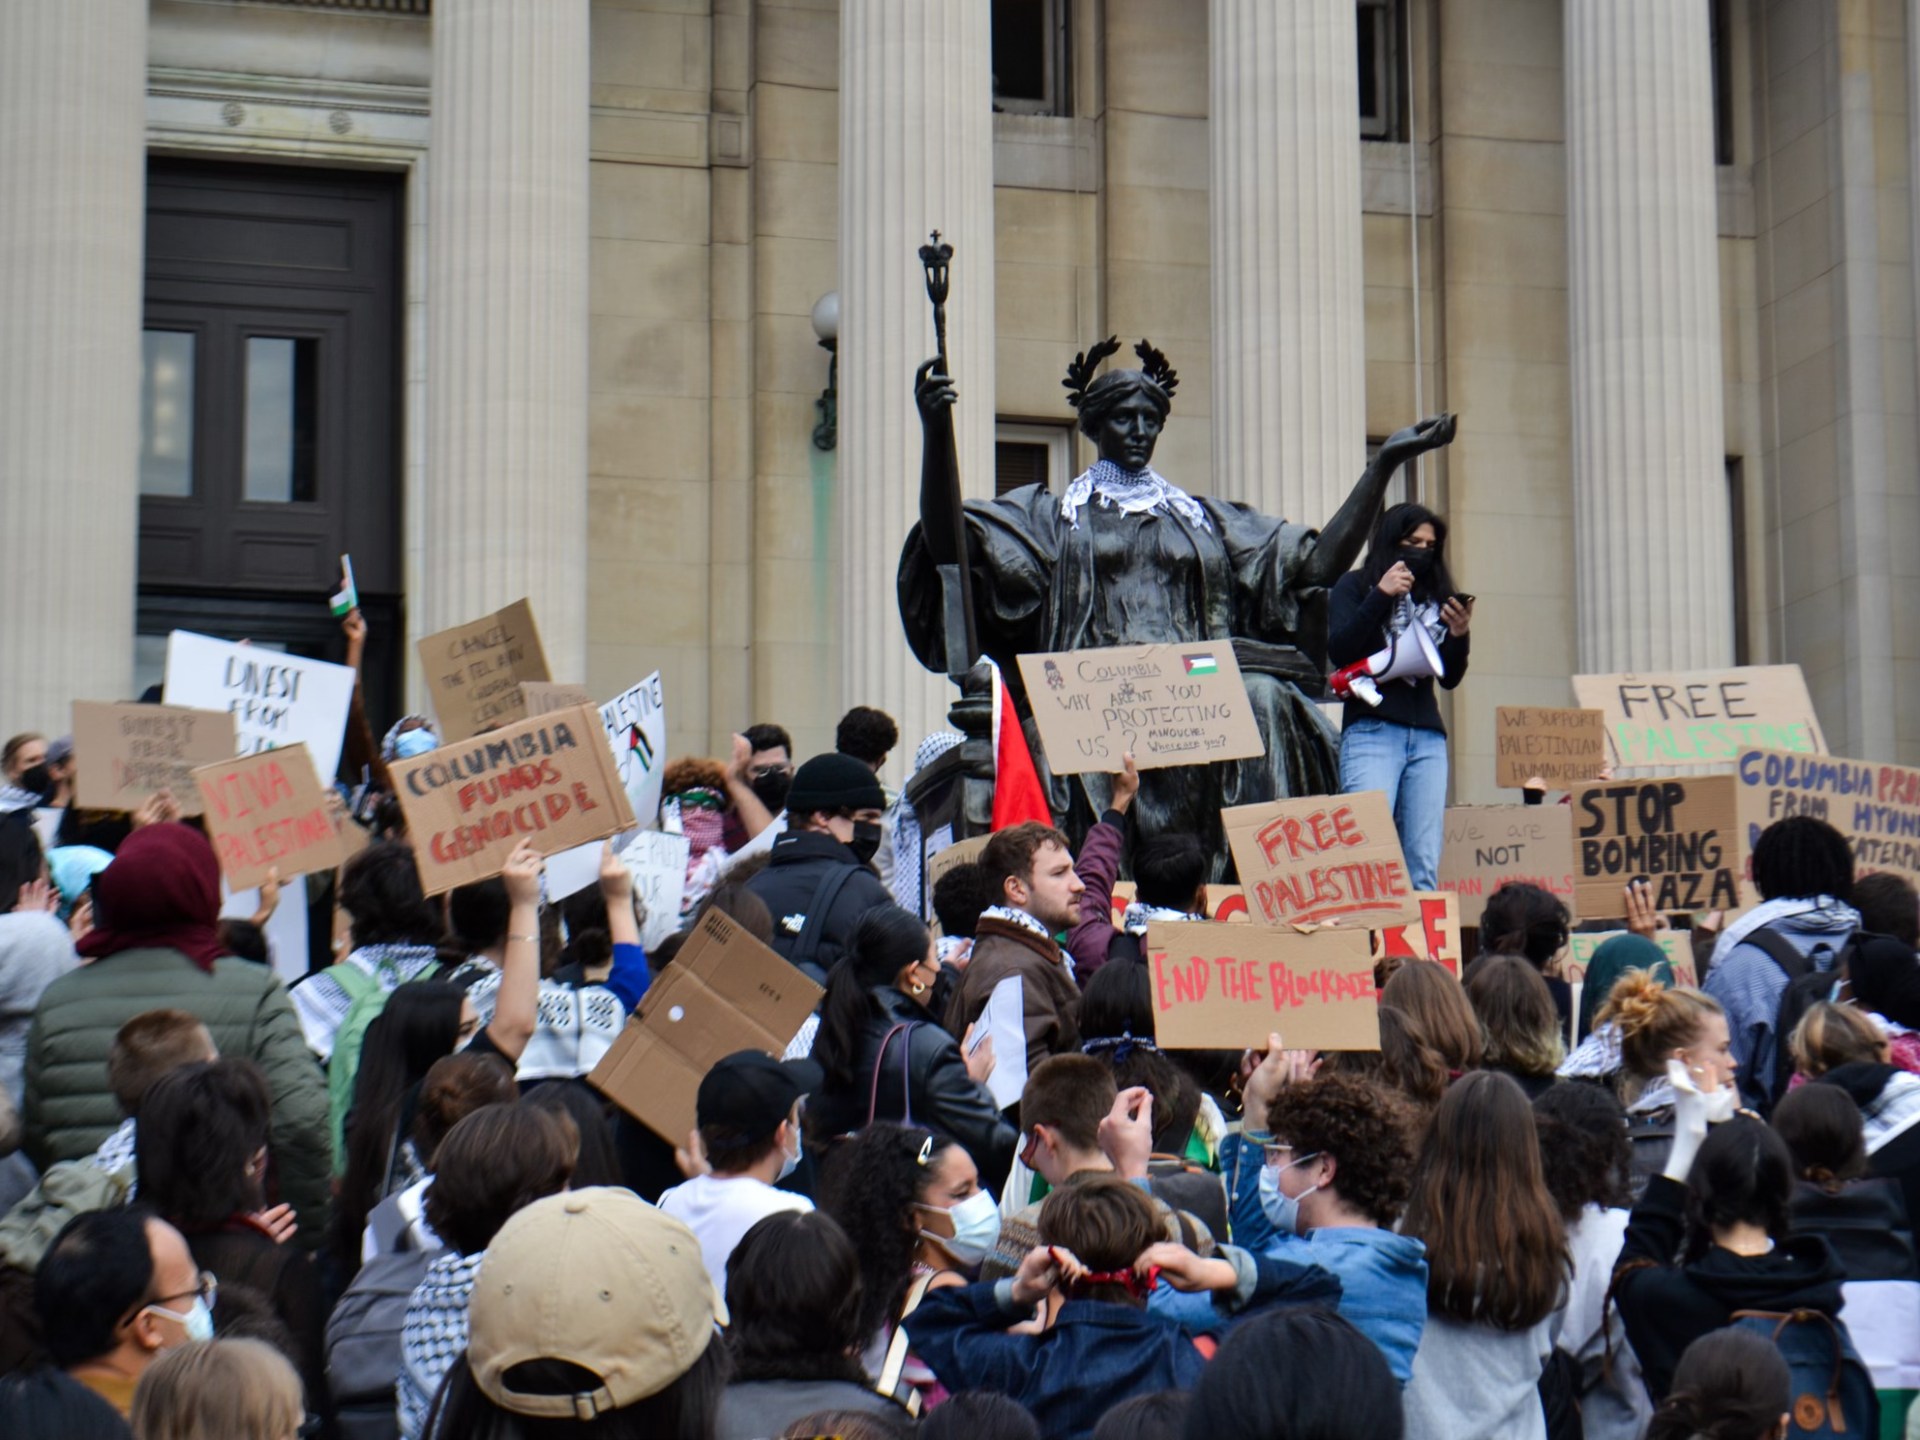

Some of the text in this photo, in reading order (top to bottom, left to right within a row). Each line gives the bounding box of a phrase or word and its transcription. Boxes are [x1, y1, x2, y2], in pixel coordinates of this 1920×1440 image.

[1077, 659, 1162, 681] COLUMBIA
[603, 676, 662, 735] ALESTINE
[1056, 692, 1091, 711] WHY
[1166, 684, 1201, 700] YOU
[1102, 702, 1231, 731] PROTECTING
[1503, 710, 1600, 728] WE SUPPORT
[1619, 682, 1757, 720] FREE
[404, 722, 577, 798] COLUMBIA
[1499, 734, 1602, 755] PALESTINIAN
[1619, 722, 1812, 763] PALESTINE
[202, 762, 294, 820] VIVA
[457, 759, 561, 814] FUNDS
[1511, 762, 1561, 781] HUMAN
[1740, 751, 1920, 806] COLUMBIA PRO
[430, 781, 599, 866] GENOCIDE
[1580, 783, 1685, 838] STOP
[1768, 789, 1829, 822] FROM
[1256, 807, 1363, 867] FREE
[1446, 819, 1546, 844] We are
[1583, 829, 1722, 877] BOMBING
[1475, 844, 1526, 867] NOT
[1255, 861, 1407, 921] PALESTINE
[1153, 953, 1378, 1012] END THE BLOCKADE
